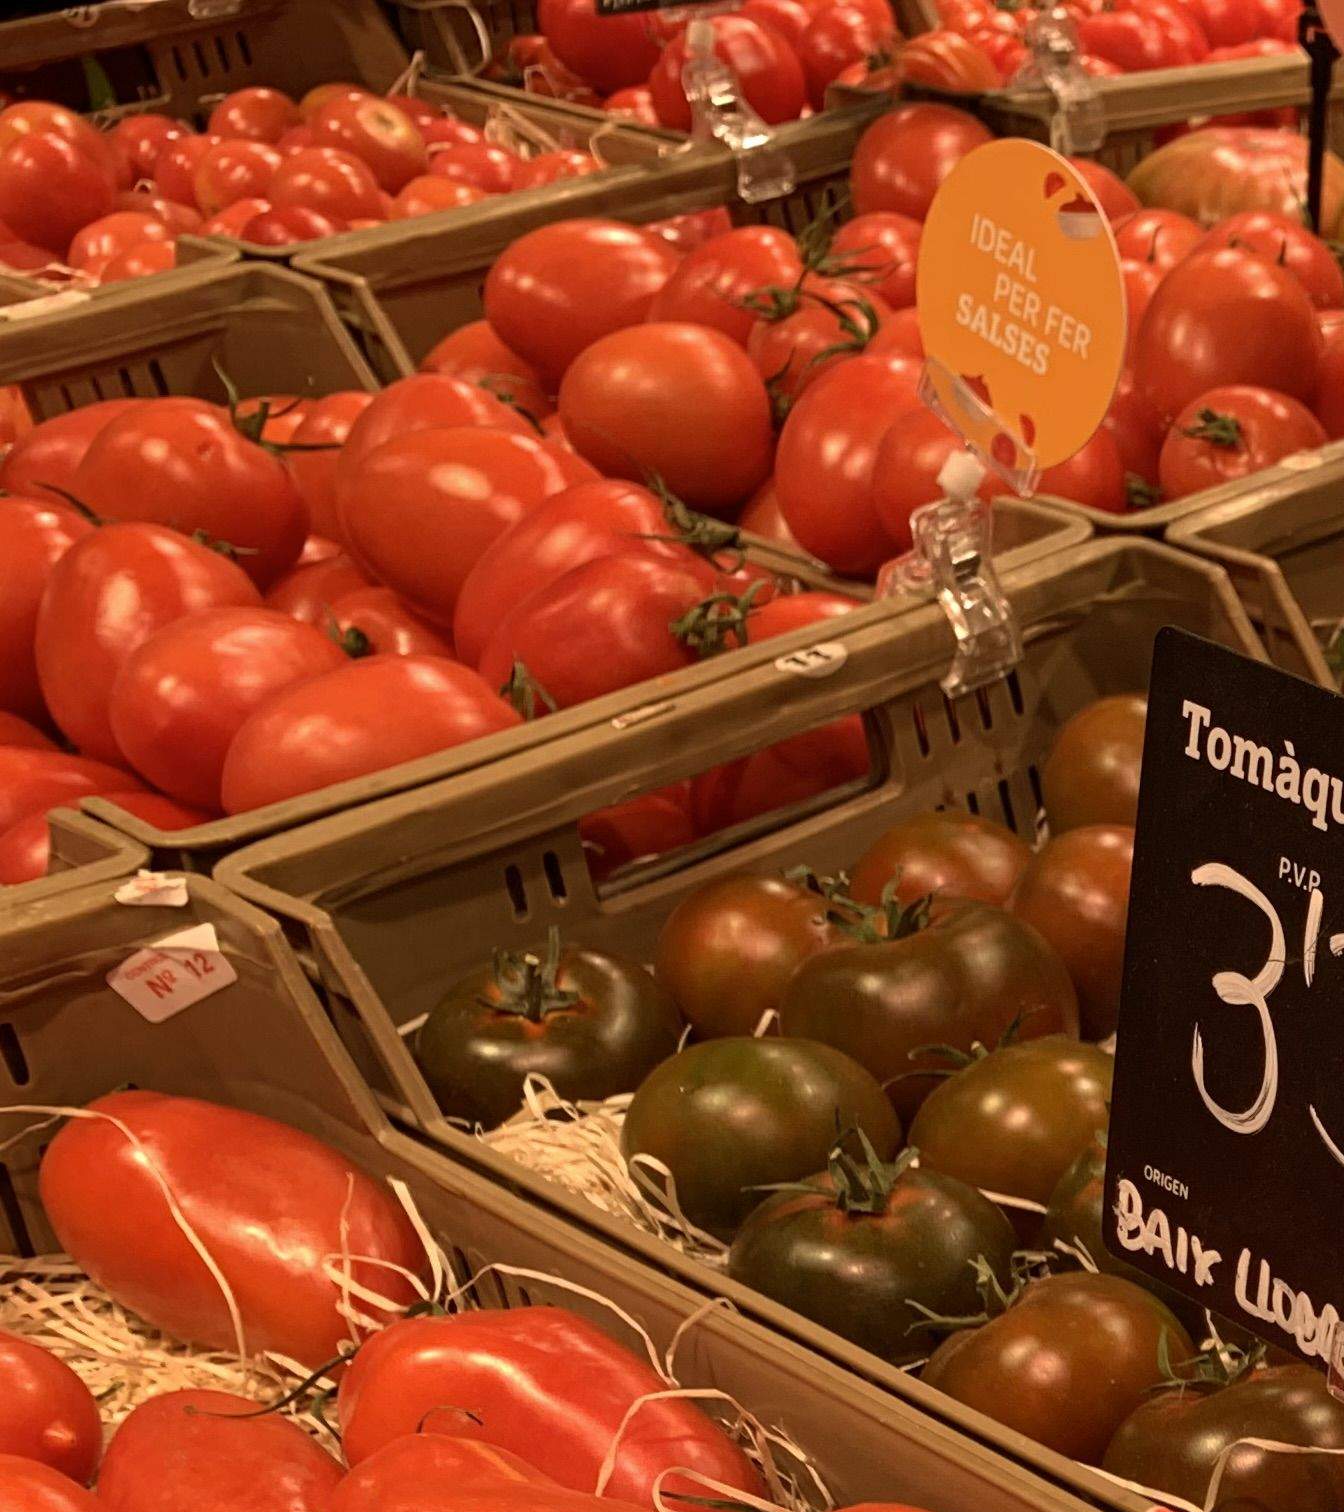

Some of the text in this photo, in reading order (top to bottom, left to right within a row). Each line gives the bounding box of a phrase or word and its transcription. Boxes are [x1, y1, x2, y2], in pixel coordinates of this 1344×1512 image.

[969, 213, 1039, 283] IDEAL
[955, 293, 1051, 377] SALSES
[993, 272, 1093, 361] PER FER
[184, 951, 215, 981] 12
[1143, 1164, 1190, 1201] ORIGEN
[1115, 1178, 1223, 1287] BAIX
